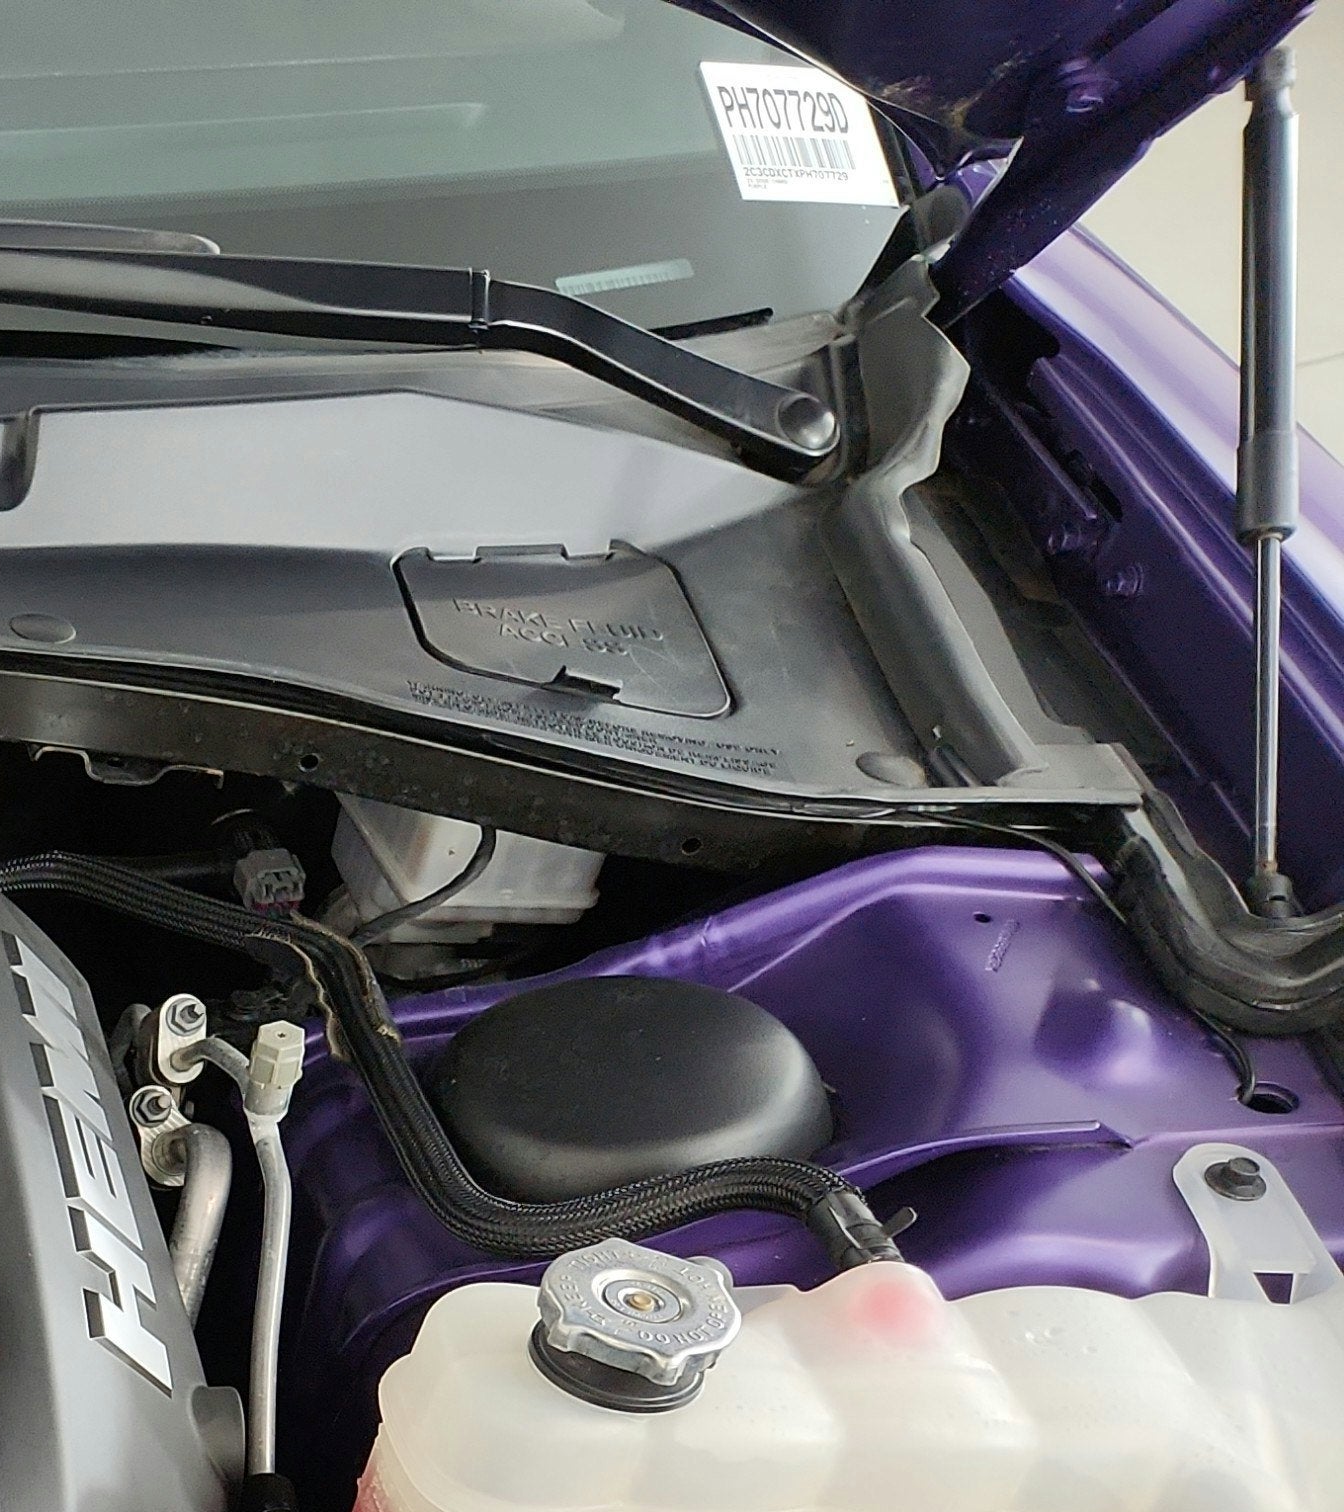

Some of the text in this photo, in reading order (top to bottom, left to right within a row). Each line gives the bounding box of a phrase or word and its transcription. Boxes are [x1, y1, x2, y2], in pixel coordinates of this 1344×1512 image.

[716, 86, 849, 134] PH707729D
[743, 166, 849, 181] 2C3CDXCTXPH707729
[452, 598, 664, 642] BRAKE FLUID
[2, 931, 172, 1398] HEMI
[672, 1326, 712, 1344] NOT
